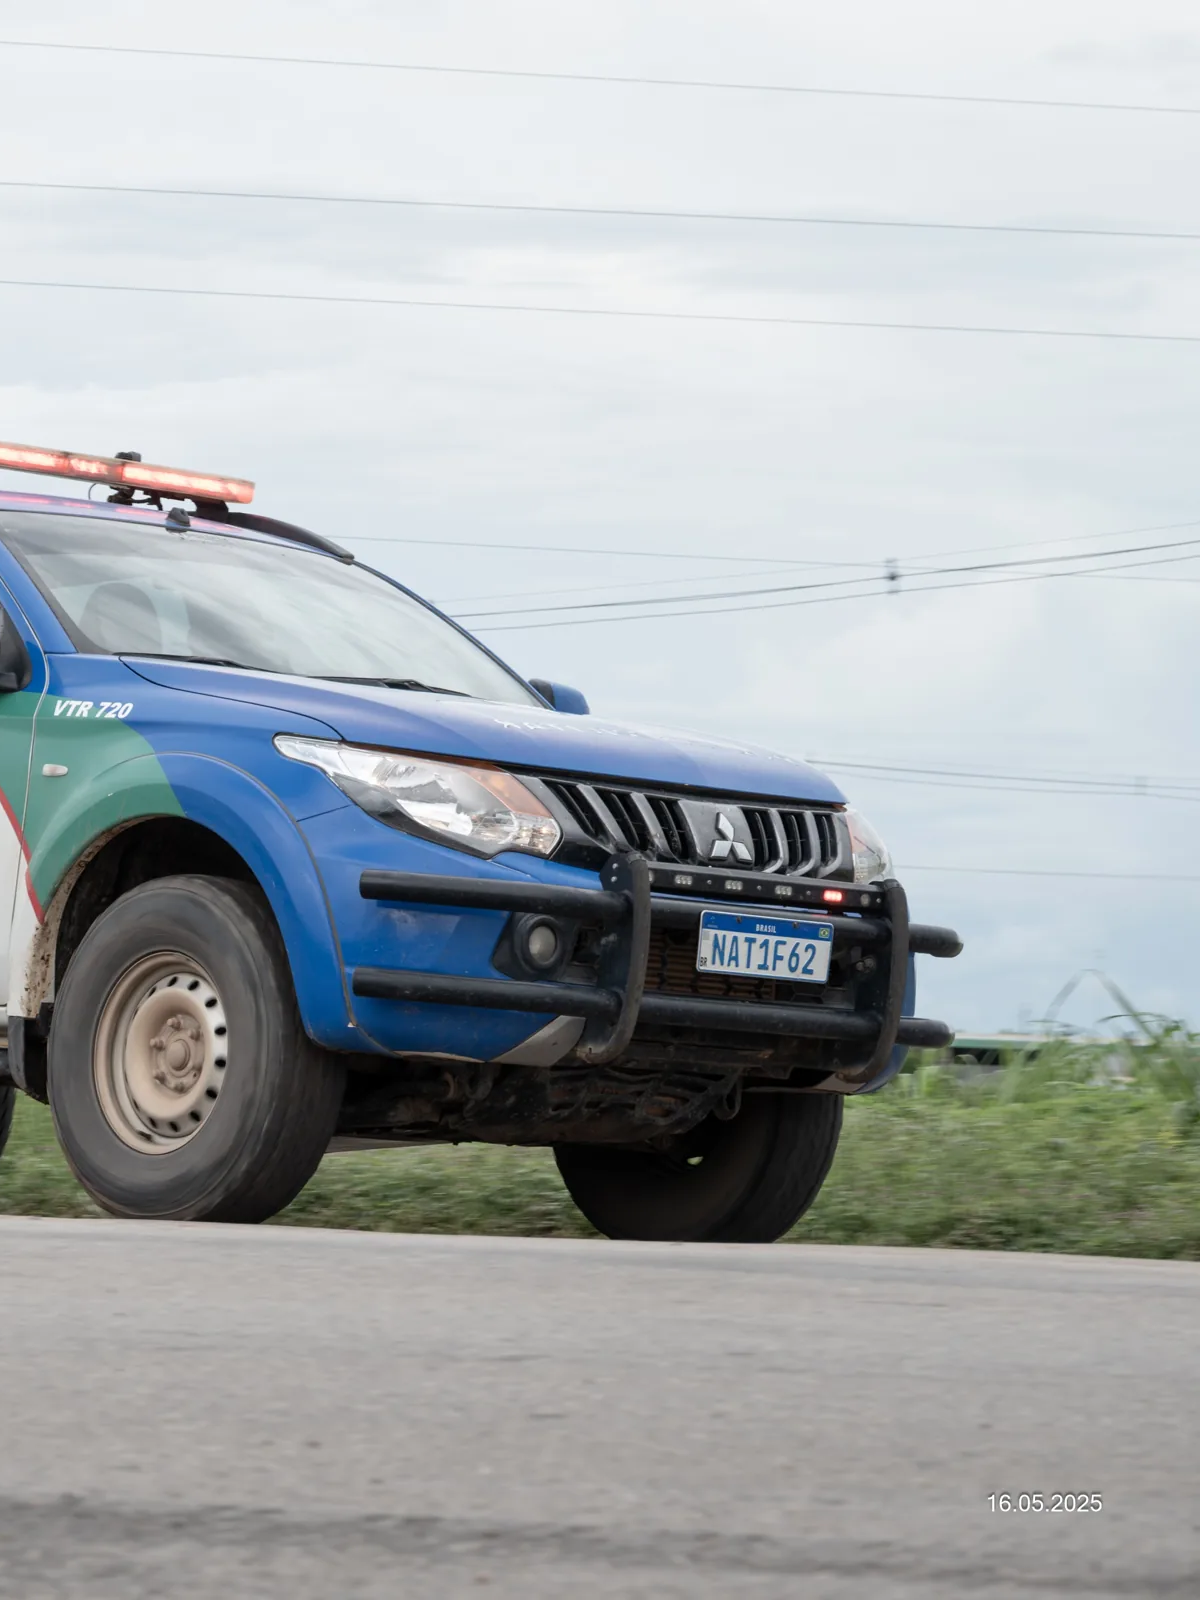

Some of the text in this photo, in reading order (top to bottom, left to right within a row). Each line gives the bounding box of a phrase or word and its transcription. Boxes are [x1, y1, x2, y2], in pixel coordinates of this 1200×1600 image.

[54, 700, 134, 719] VTR 720
[755, 924, 777, 934] BRASIL
[699, 956, 708, 967] BR
[711, 933, 817, 976] NAT1F62
